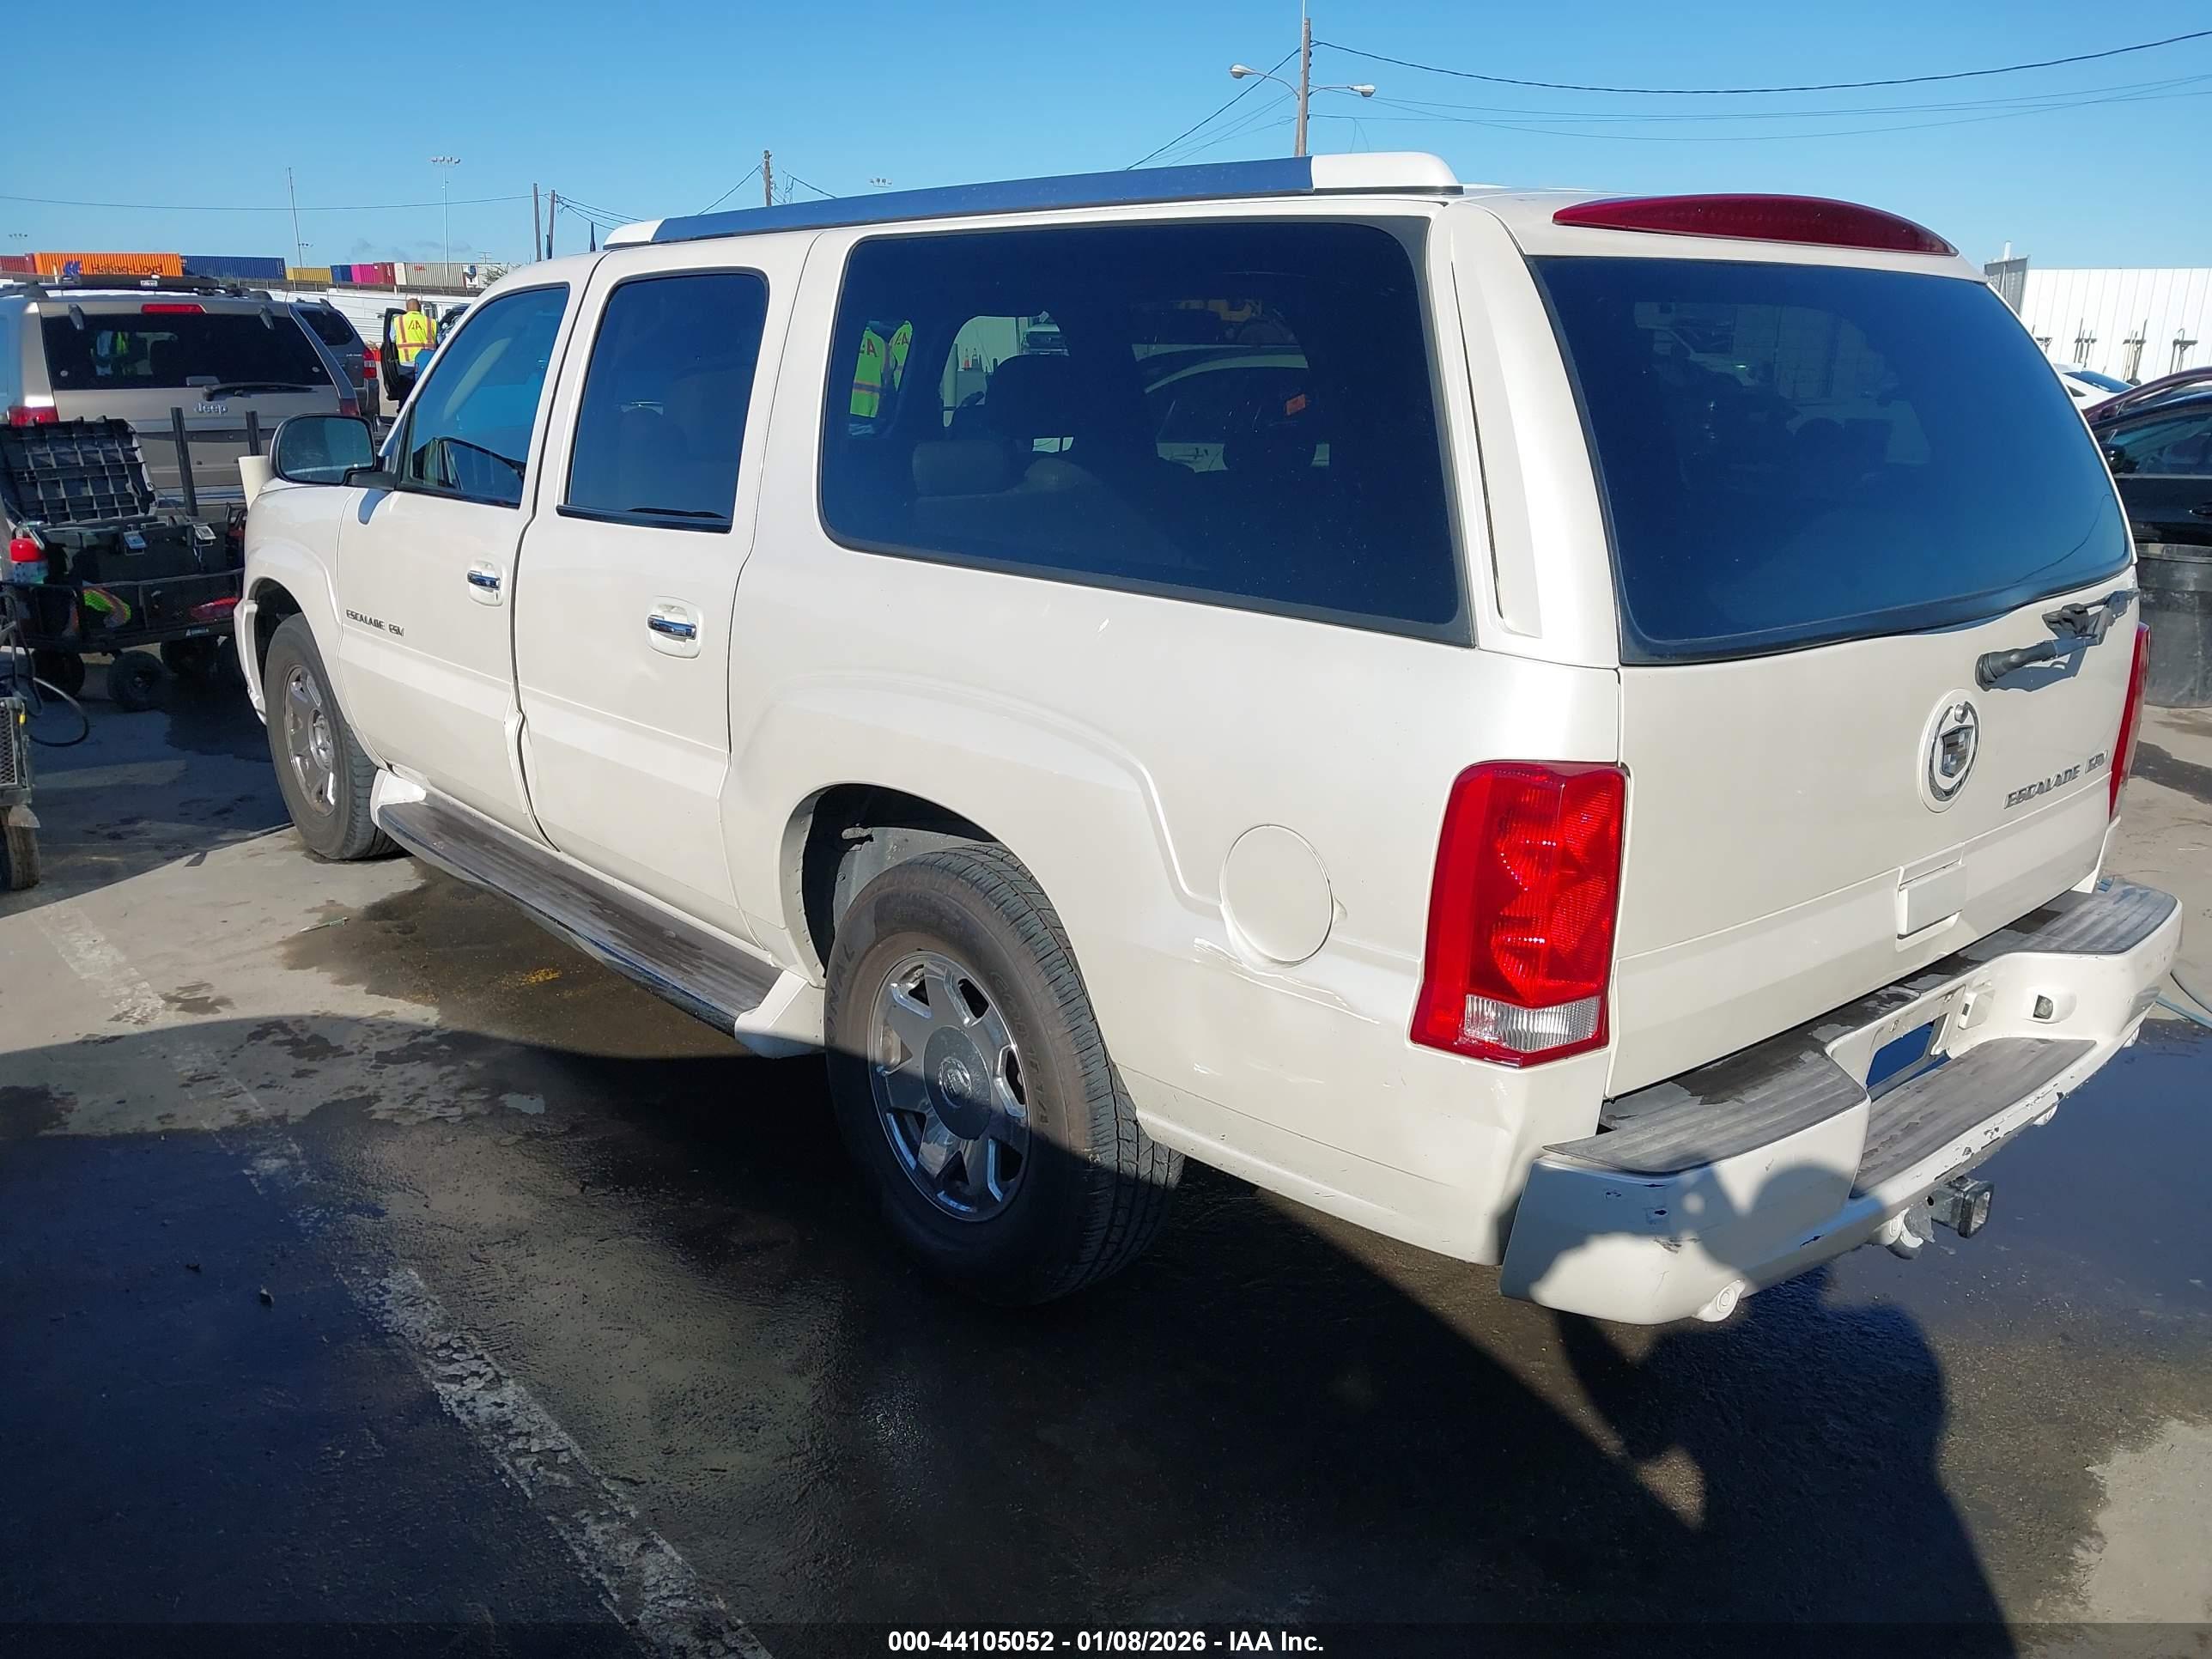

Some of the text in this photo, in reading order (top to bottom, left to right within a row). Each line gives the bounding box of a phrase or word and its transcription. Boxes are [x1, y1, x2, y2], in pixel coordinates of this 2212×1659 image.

[193, 401, 228, 416] Jeep
[345, 609, 404, 637] ESCALADE ESV
[2003, 764, 2082, 809] ESCALADE
